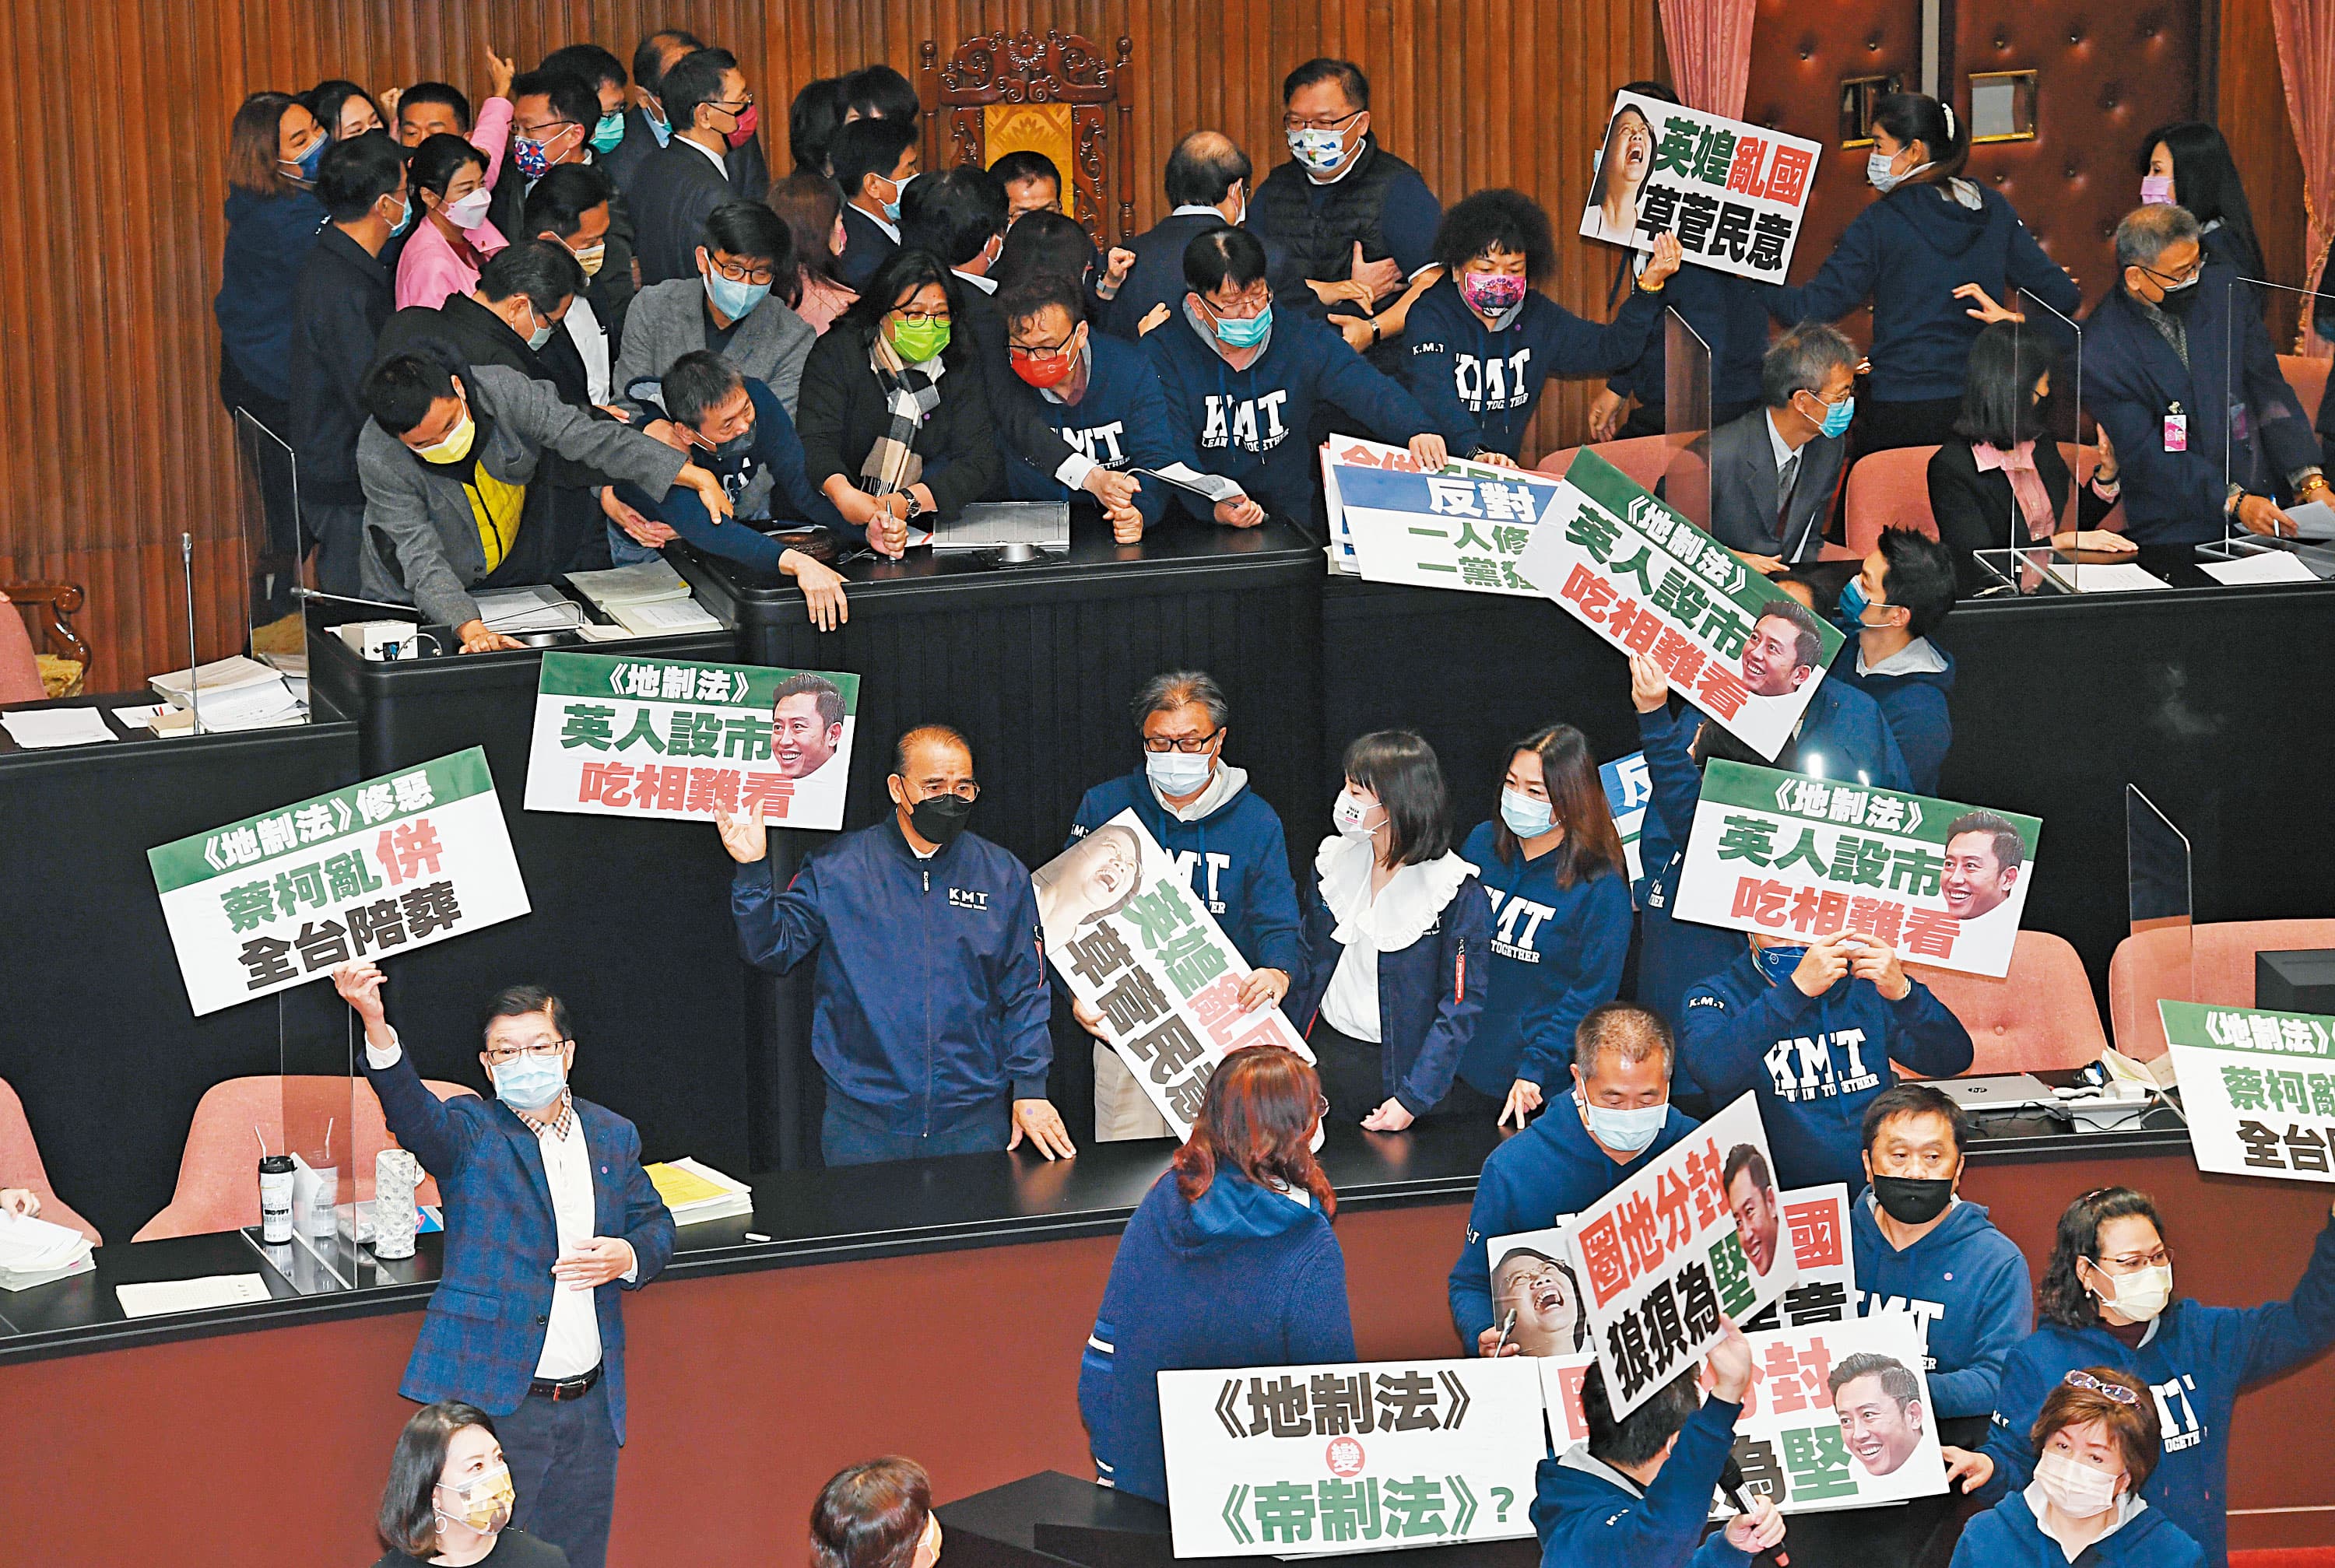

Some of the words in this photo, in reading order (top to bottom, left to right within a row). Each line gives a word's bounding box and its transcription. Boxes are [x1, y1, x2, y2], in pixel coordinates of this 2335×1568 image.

[1635, 184, 1793, 272] 草菅民意
[1426, 476, 1537, 523] 反對
[1627, 495, 1747, 596] 《地制法》
[1565, 503, 1757, 661] 英人設市
[1561, 563, 1749, 721] 吃相難看
[606, 665, 751, 705] 《地制法》
[560, 704, 774, 762] 英人設市
[580, 763, 795, 819] 吃相難看
[1775, 777, 1923, 834] 《地制法》
[219, 818, 444, 935] 蔡柯亂併
[1718, 815, 1944, 897] 英人設市
[949, 887, 988, 905] KMT
[1730, 877, 1961, 959] 吃相難看
[238, 880, 462, 991] 全台陪葬
[1491, 938, 1540, 963] TOGETHER
[1764, 1028, 1866, 1089] KMT
[2236, 1120, 2335, 1173] 全台
[1578, 1136, 1732, 1310] 圈地分封
[1215, 1370, 1470, 1438] 《地制法》
[1331, 1442, 1361, 1474] 變
